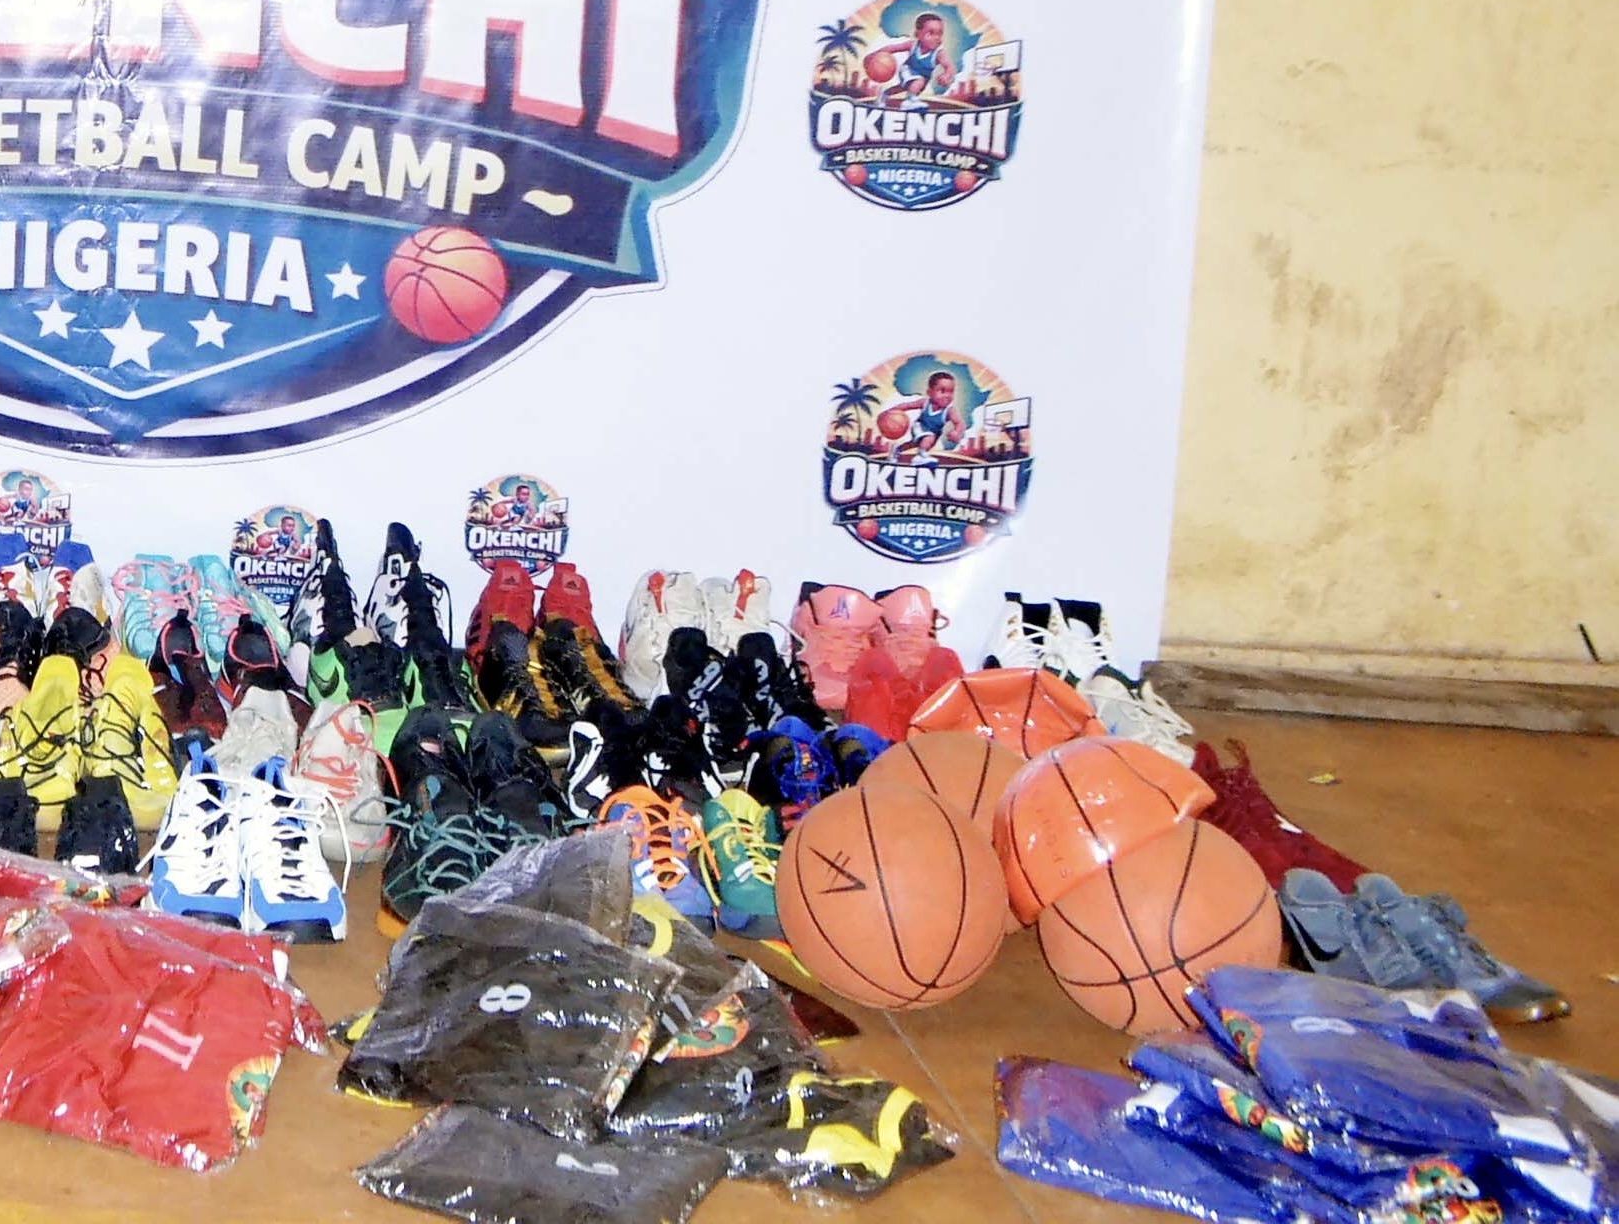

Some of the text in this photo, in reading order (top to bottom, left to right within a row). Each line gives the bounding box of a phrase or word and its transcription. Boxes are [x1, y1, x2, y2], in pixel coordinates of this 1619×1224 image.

[817, 100, 1009, 159] OKENCHI
[284, 117, 506, 217] CAMP
[846, 148, 977, 169] BASKETBALL CAMP
[878, 168, 942, 185] NIGERIA
[831, 456, 1019, 512] OKENCHI
[859, 502, 985, 523] BASKETBALL CAMP
[468, 526, 562, 554] OKENCHI
[889, 523, 951, 540] NIGERIA
[291, 578, 302, 586] CA
[480, 983, 531, 1013] 8
[132, 1012, 204, 1071] 11
